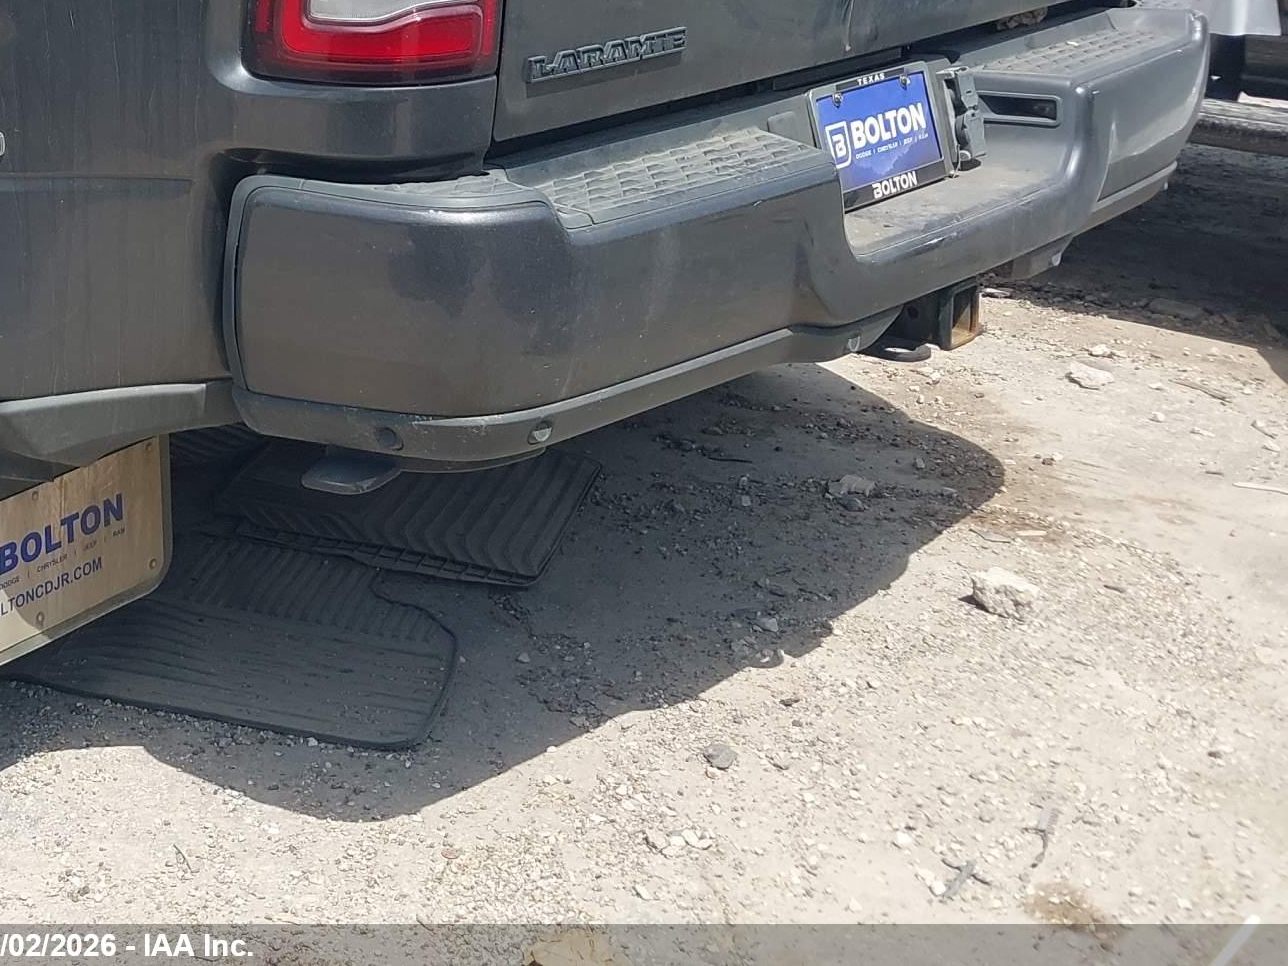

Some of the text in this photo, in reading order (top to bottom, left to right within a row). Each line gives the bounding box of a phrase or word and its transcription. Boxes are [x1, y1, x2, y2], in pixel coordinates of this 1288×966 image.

[857, 73, 885, 85] TEXAS
[850, 102, 926, 149] BOLTON
[871, 171, 918, 199] BOLTON
